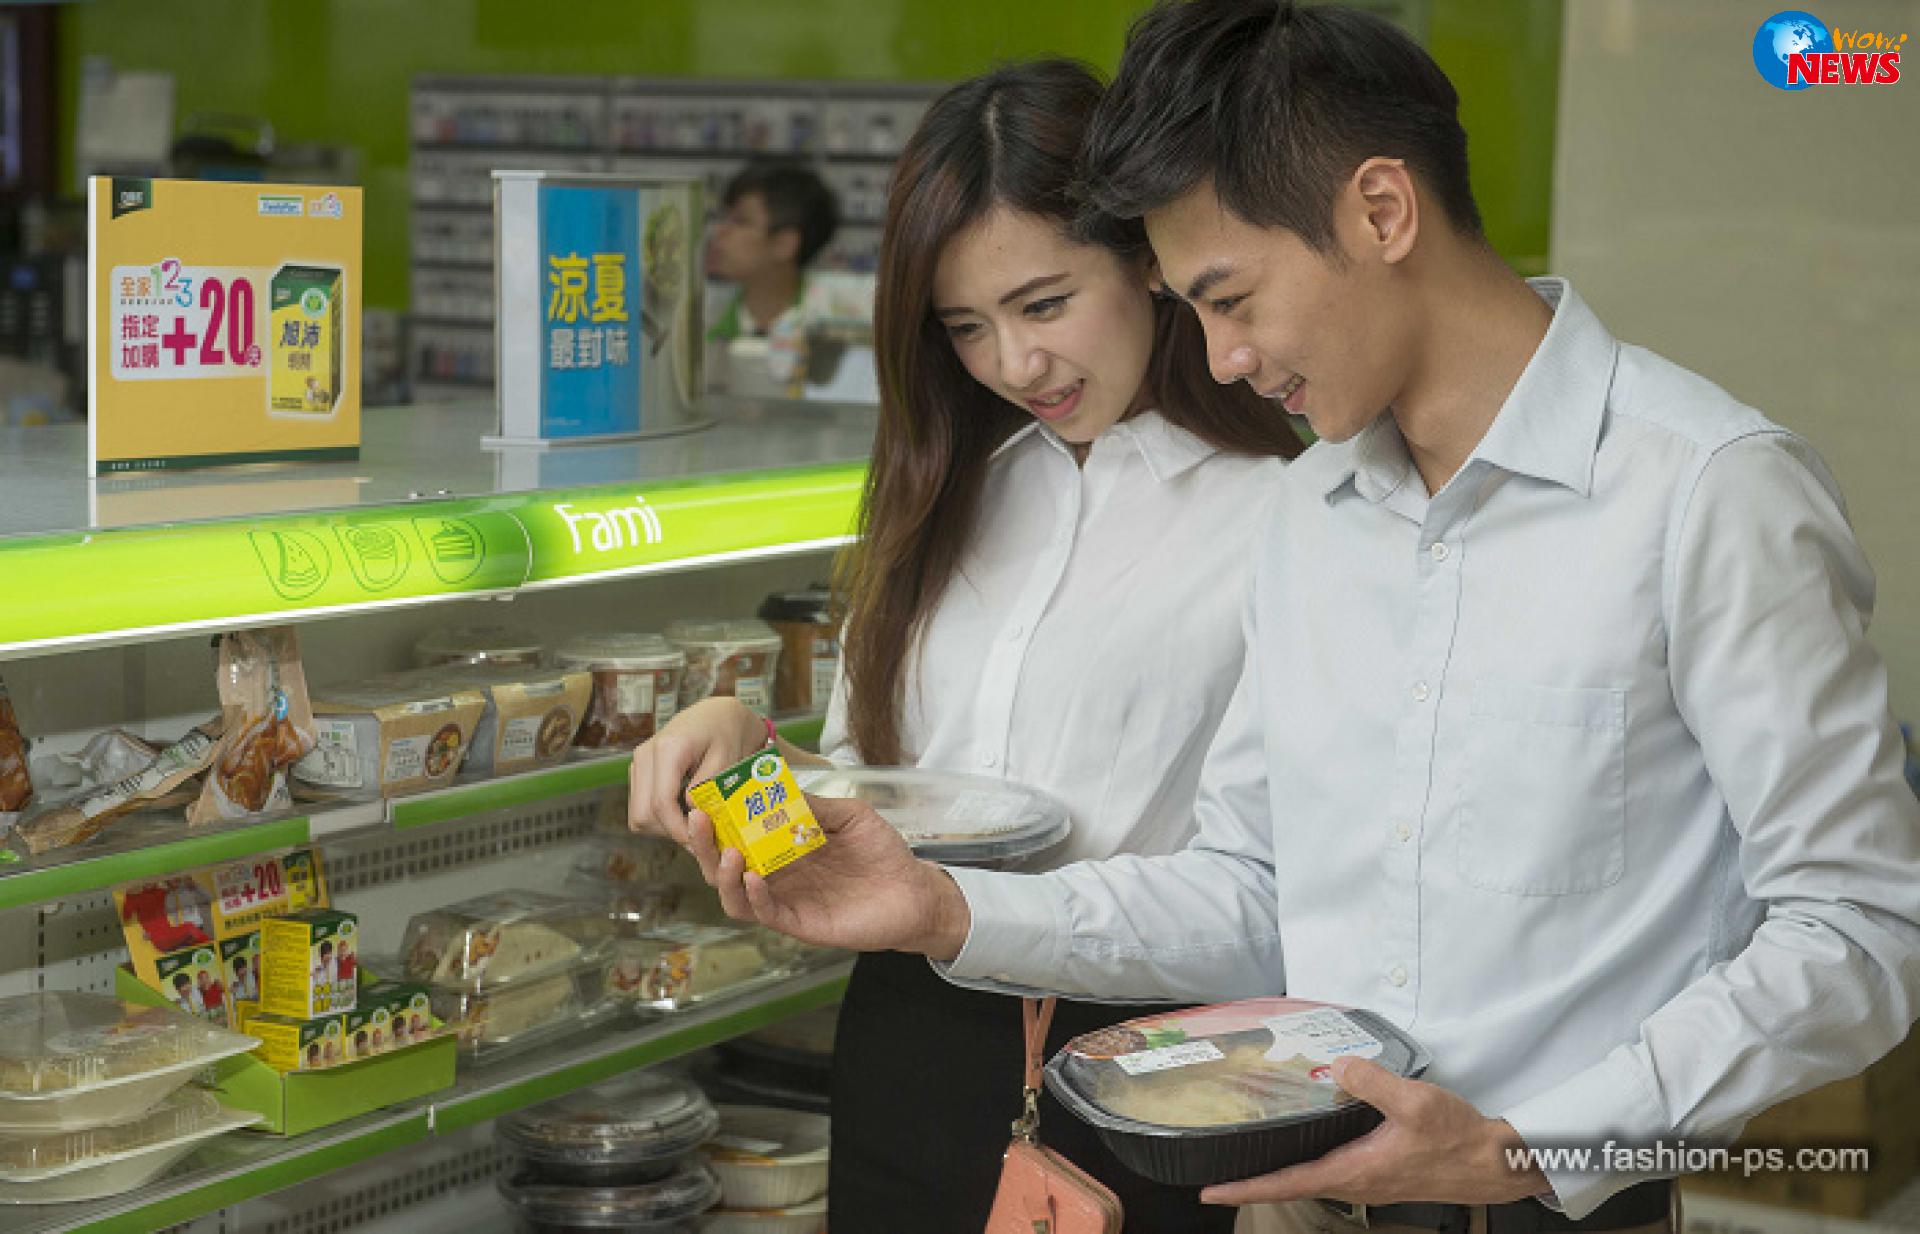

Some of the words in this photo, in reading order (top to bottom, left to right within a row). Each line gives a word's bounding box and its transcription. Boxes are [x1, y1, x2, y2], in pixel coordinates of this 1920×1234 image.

[548, 252, 629, 322] 涼夏
[121, 313, 160, 340] 指定
[121, 342, 160, 369] 加購
[550, 328, 629, 370] 最對味
[553, 494, 662, 554] Fami
